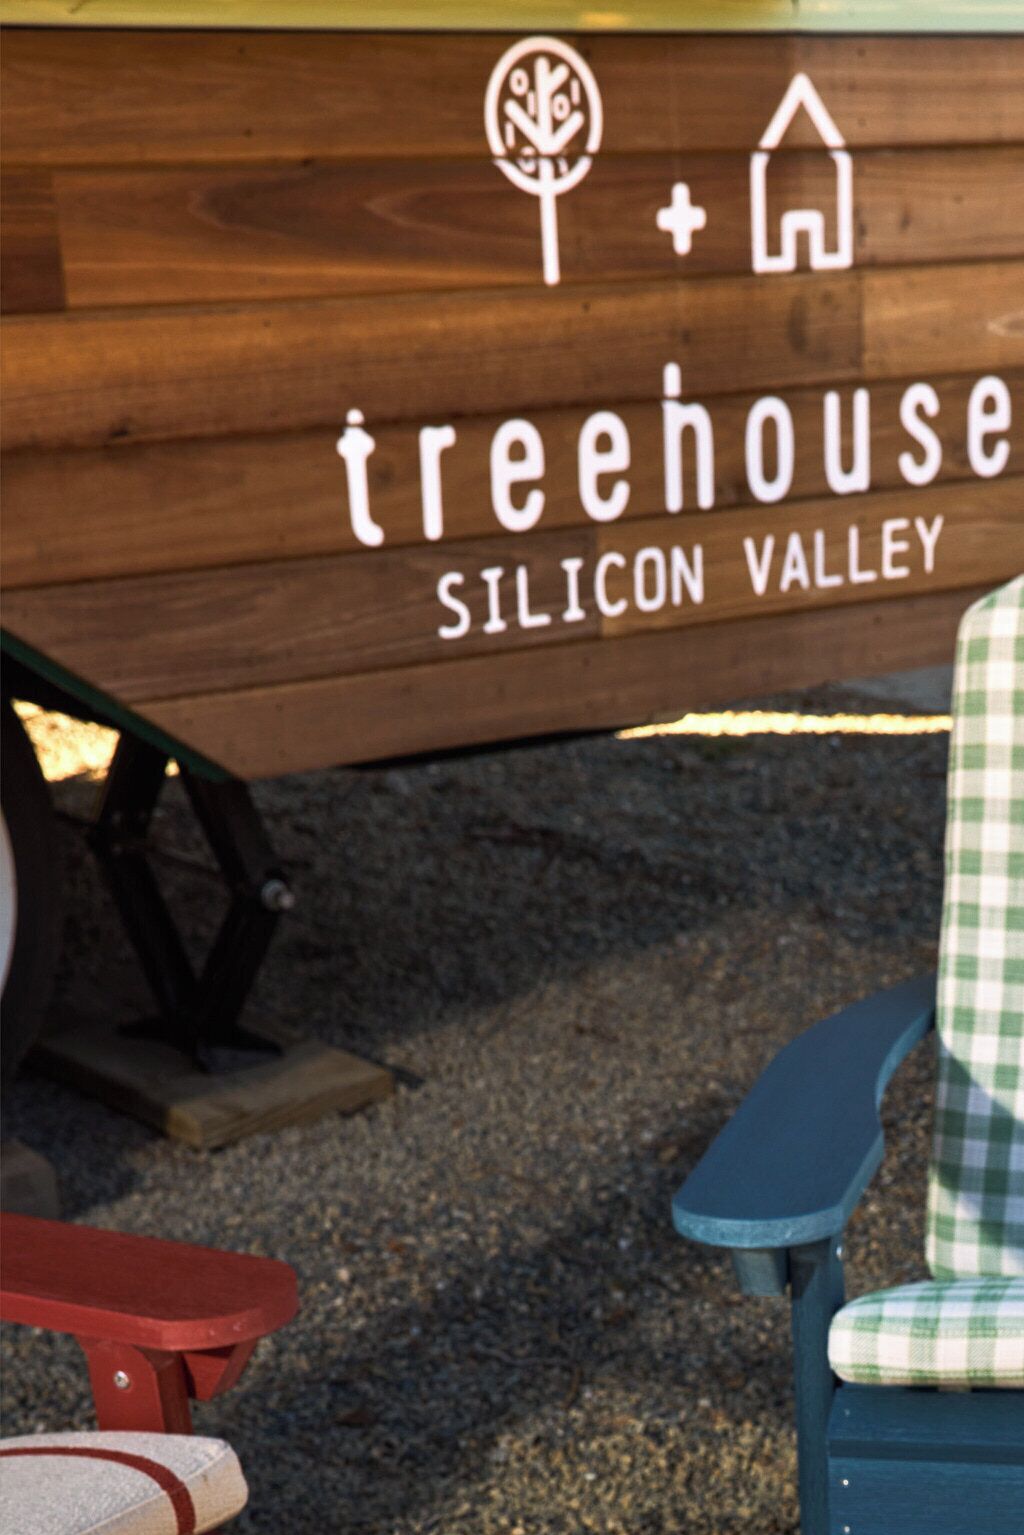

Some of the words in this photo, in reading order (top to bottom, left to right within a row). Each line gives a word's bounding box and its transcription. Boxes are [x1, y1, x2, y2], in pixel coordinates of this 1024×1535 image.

[336, 362, 1012, 548] treehouse
[436, 544, 704, 640] SILICON
[743, 515, 945, 596] VALLEY
